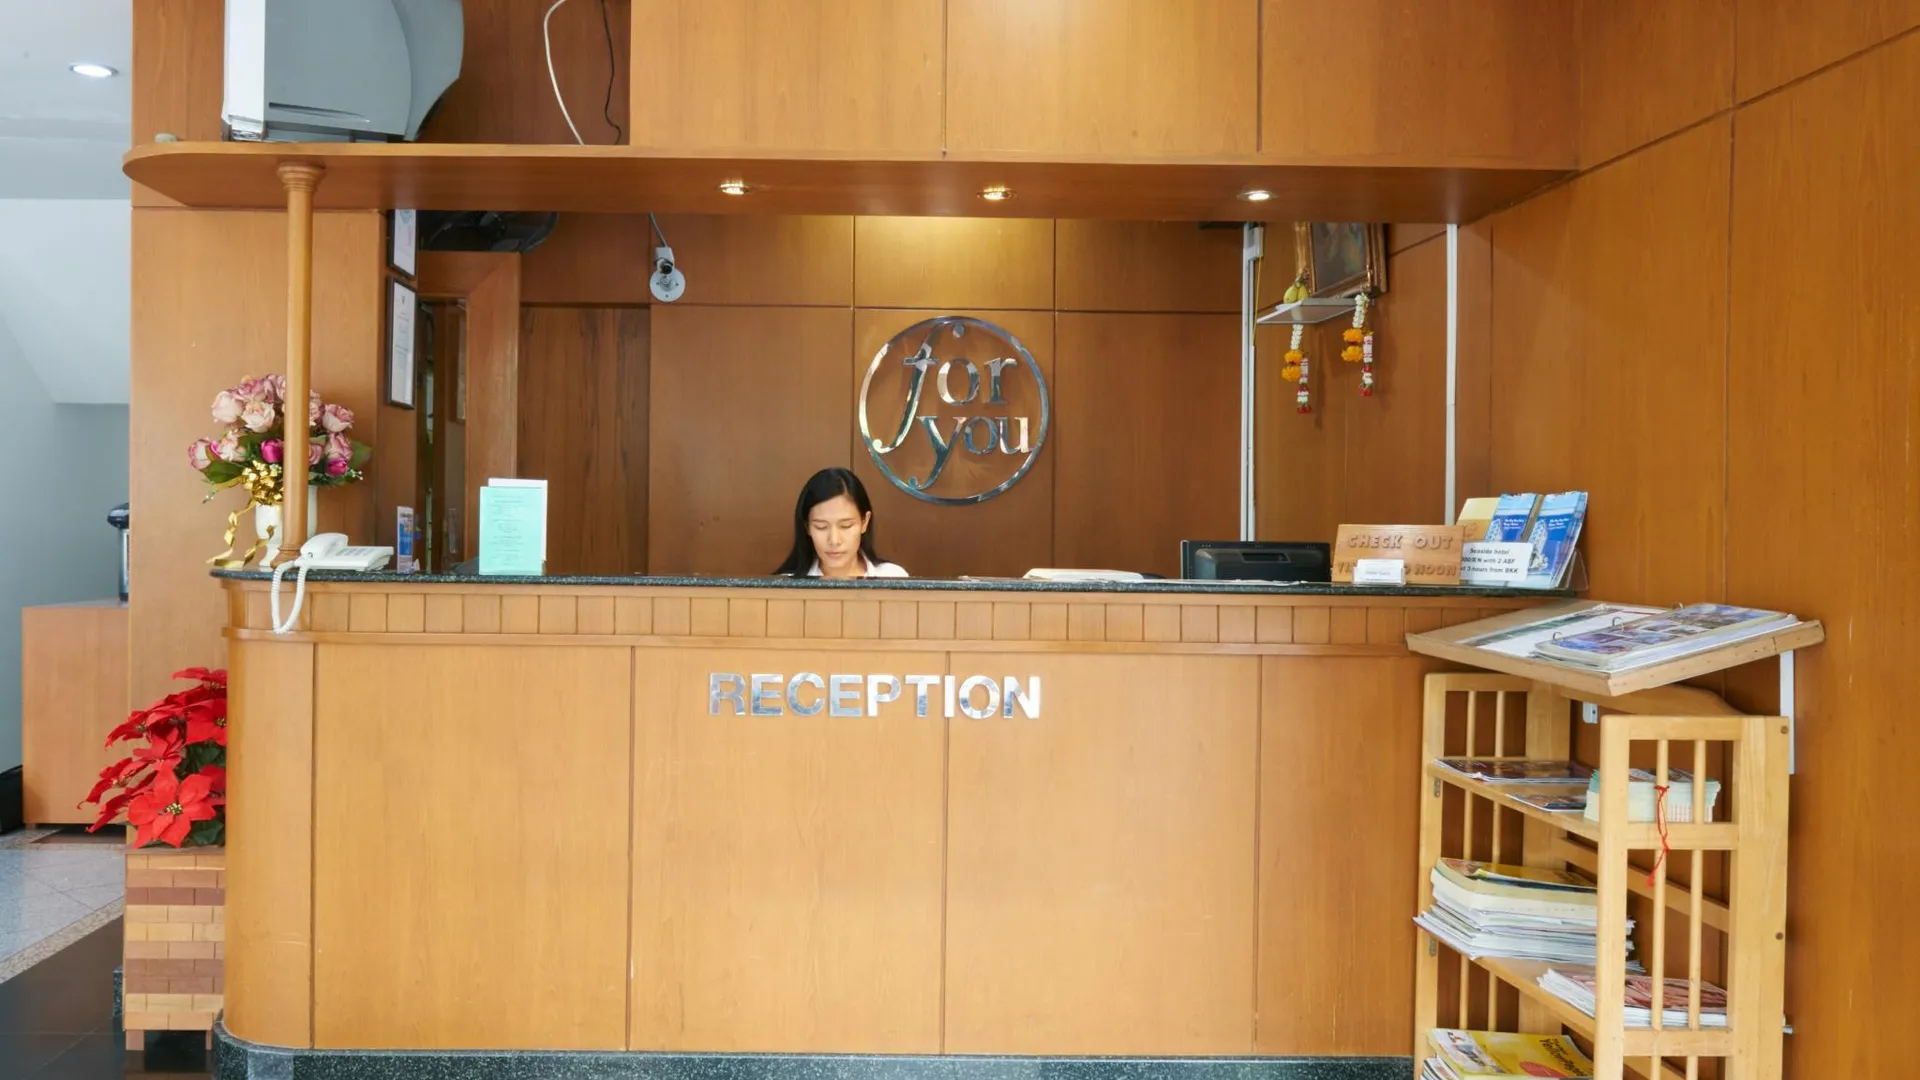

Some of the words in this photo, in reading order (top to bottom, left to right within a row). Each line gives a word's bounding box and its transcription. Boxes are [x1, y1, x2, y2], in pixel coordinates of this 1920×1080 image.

[872, 324, 1018, 454] for
[909, 416, 1032, 490] you
[1348, 534, 1404, 549] CHECK
[1414, 535, 1453, 550] OUT
[1414, 563, 1457, 577] NOON
[709, 672, 1042, 719] RECEPTION
